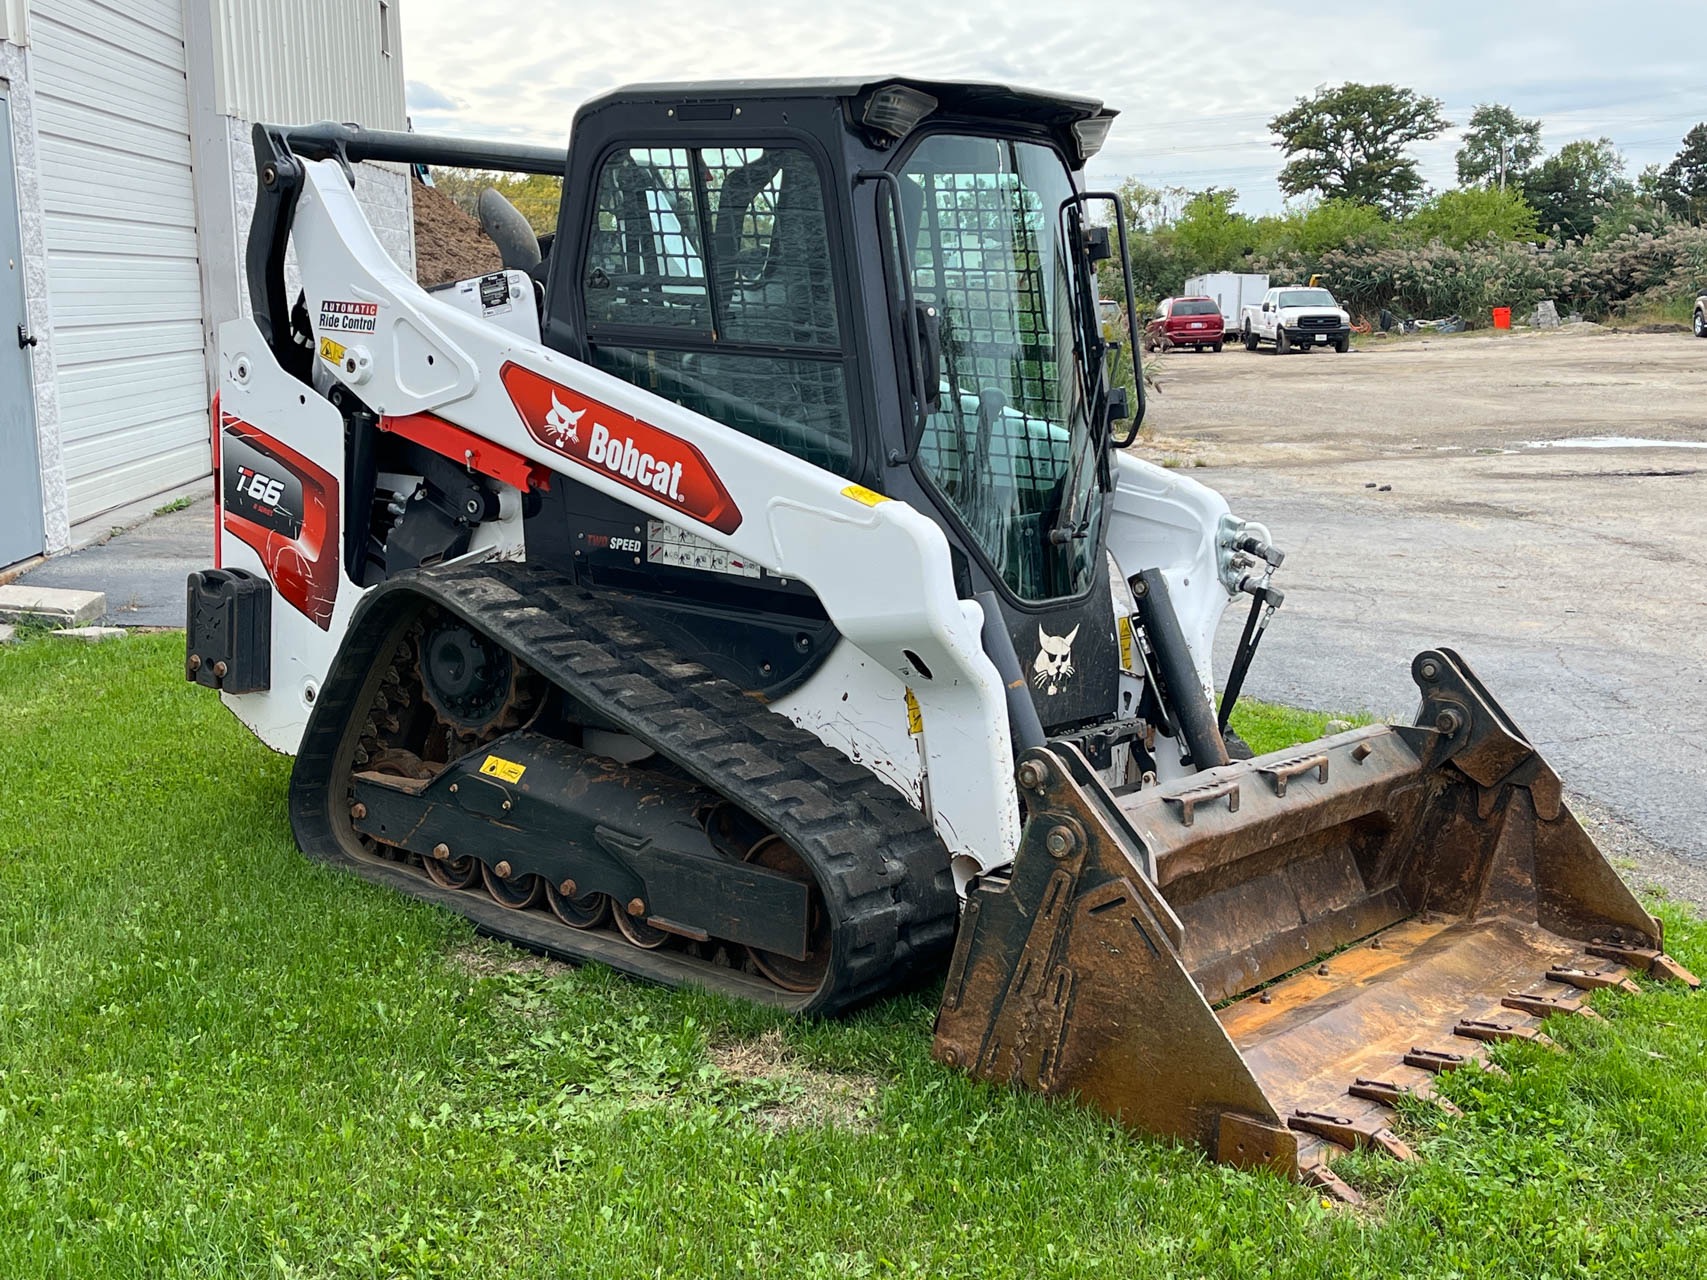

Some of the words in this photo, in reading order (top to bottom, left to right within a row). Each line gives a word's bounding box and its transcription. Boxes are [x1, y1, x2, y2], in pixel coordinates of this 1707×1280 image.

[323, 302, 376, 314] AUTOMATIC
[319, 313, 340, 328] Ride
[342, 315, 376, 331] Control
[587, 422, 682, 501] Bobcat
[236, 466, 285, 506] T66
[587, 534, 608, 547] TWO
[609, 537, 641, 552] SPEED
